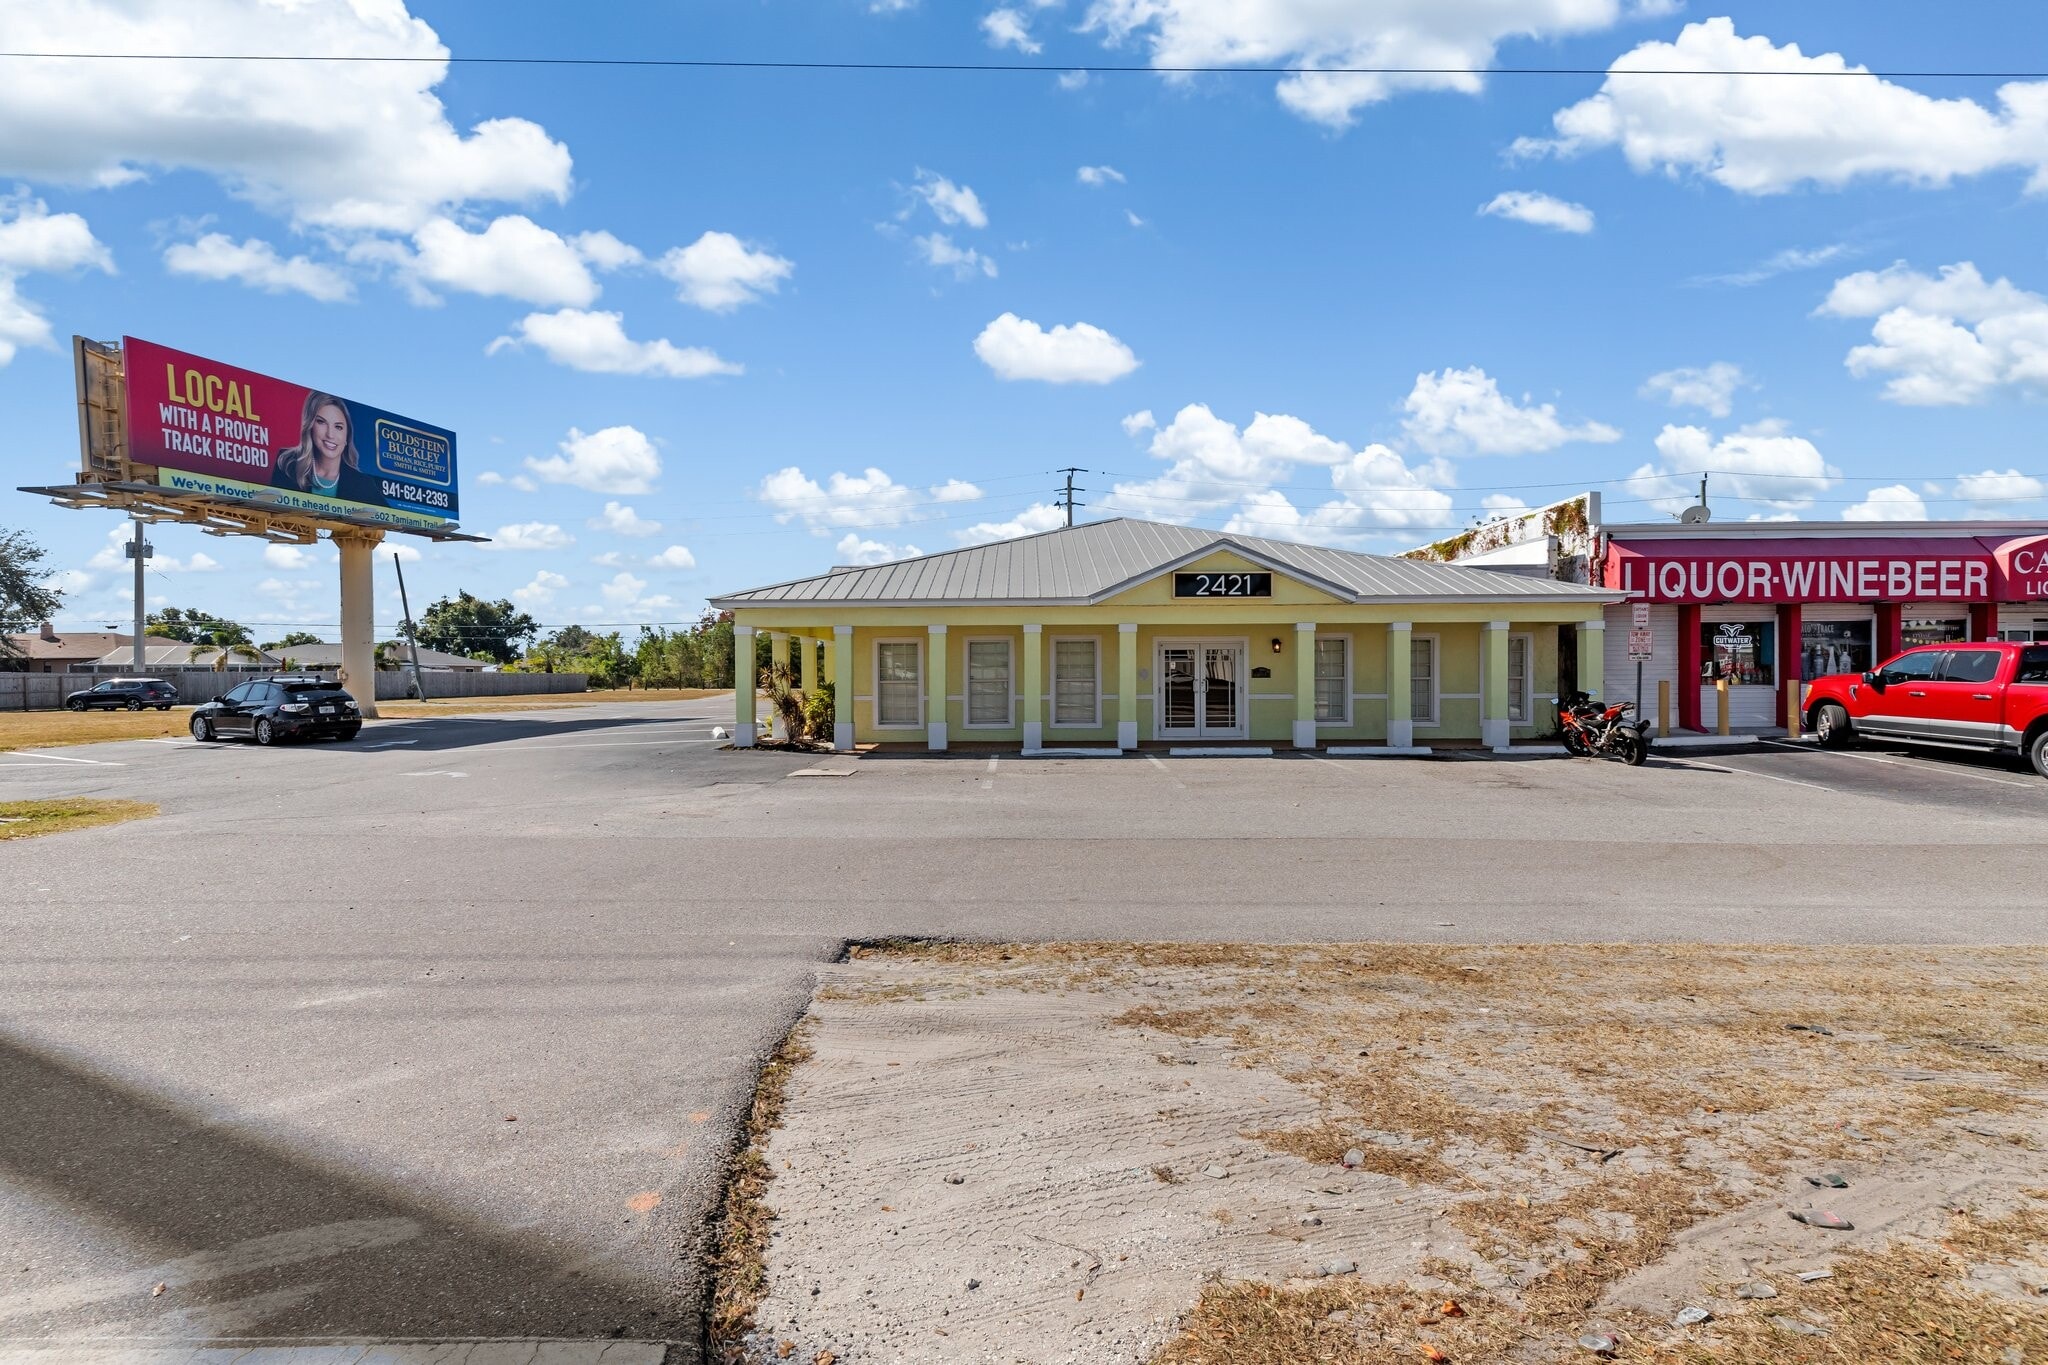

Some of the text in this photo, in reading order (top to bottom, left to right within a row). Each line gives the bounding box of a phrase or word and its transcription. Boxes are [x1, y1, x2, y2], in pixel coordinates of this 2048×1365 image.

[167, 363, 260, 421] LOCAL
[159, 402, 269, 446] WITH A PROVEN
[162, 428, 269, 468] TRACK RECORD
[382, 428, 444, 454] GOLDSTEIN
[388, 441, 440, 464] BUCKLEY
[394, 462, 412, 470] SMITH
[419, 468, 436, 476] SMITH
[171, 476, 212, 492] We've
[215, 484, 258, 499] Moved
[292, 496, 300, 506] ft
[302, 500, 330, 512] ahead
[332, 505, 342, 514] on
[370, 512, 390, 521] 602
[392, 514, 422, 527] Tamiami
[422, 520, 438, 529] Trail
[382, 480, 448, 508] 941-624-2393
[2014, 550, 2048, 574] CA
[1196, 574, 1251, 596] 2421
[1624, 560, 1988, 598] LIQUOR WINE BEER
